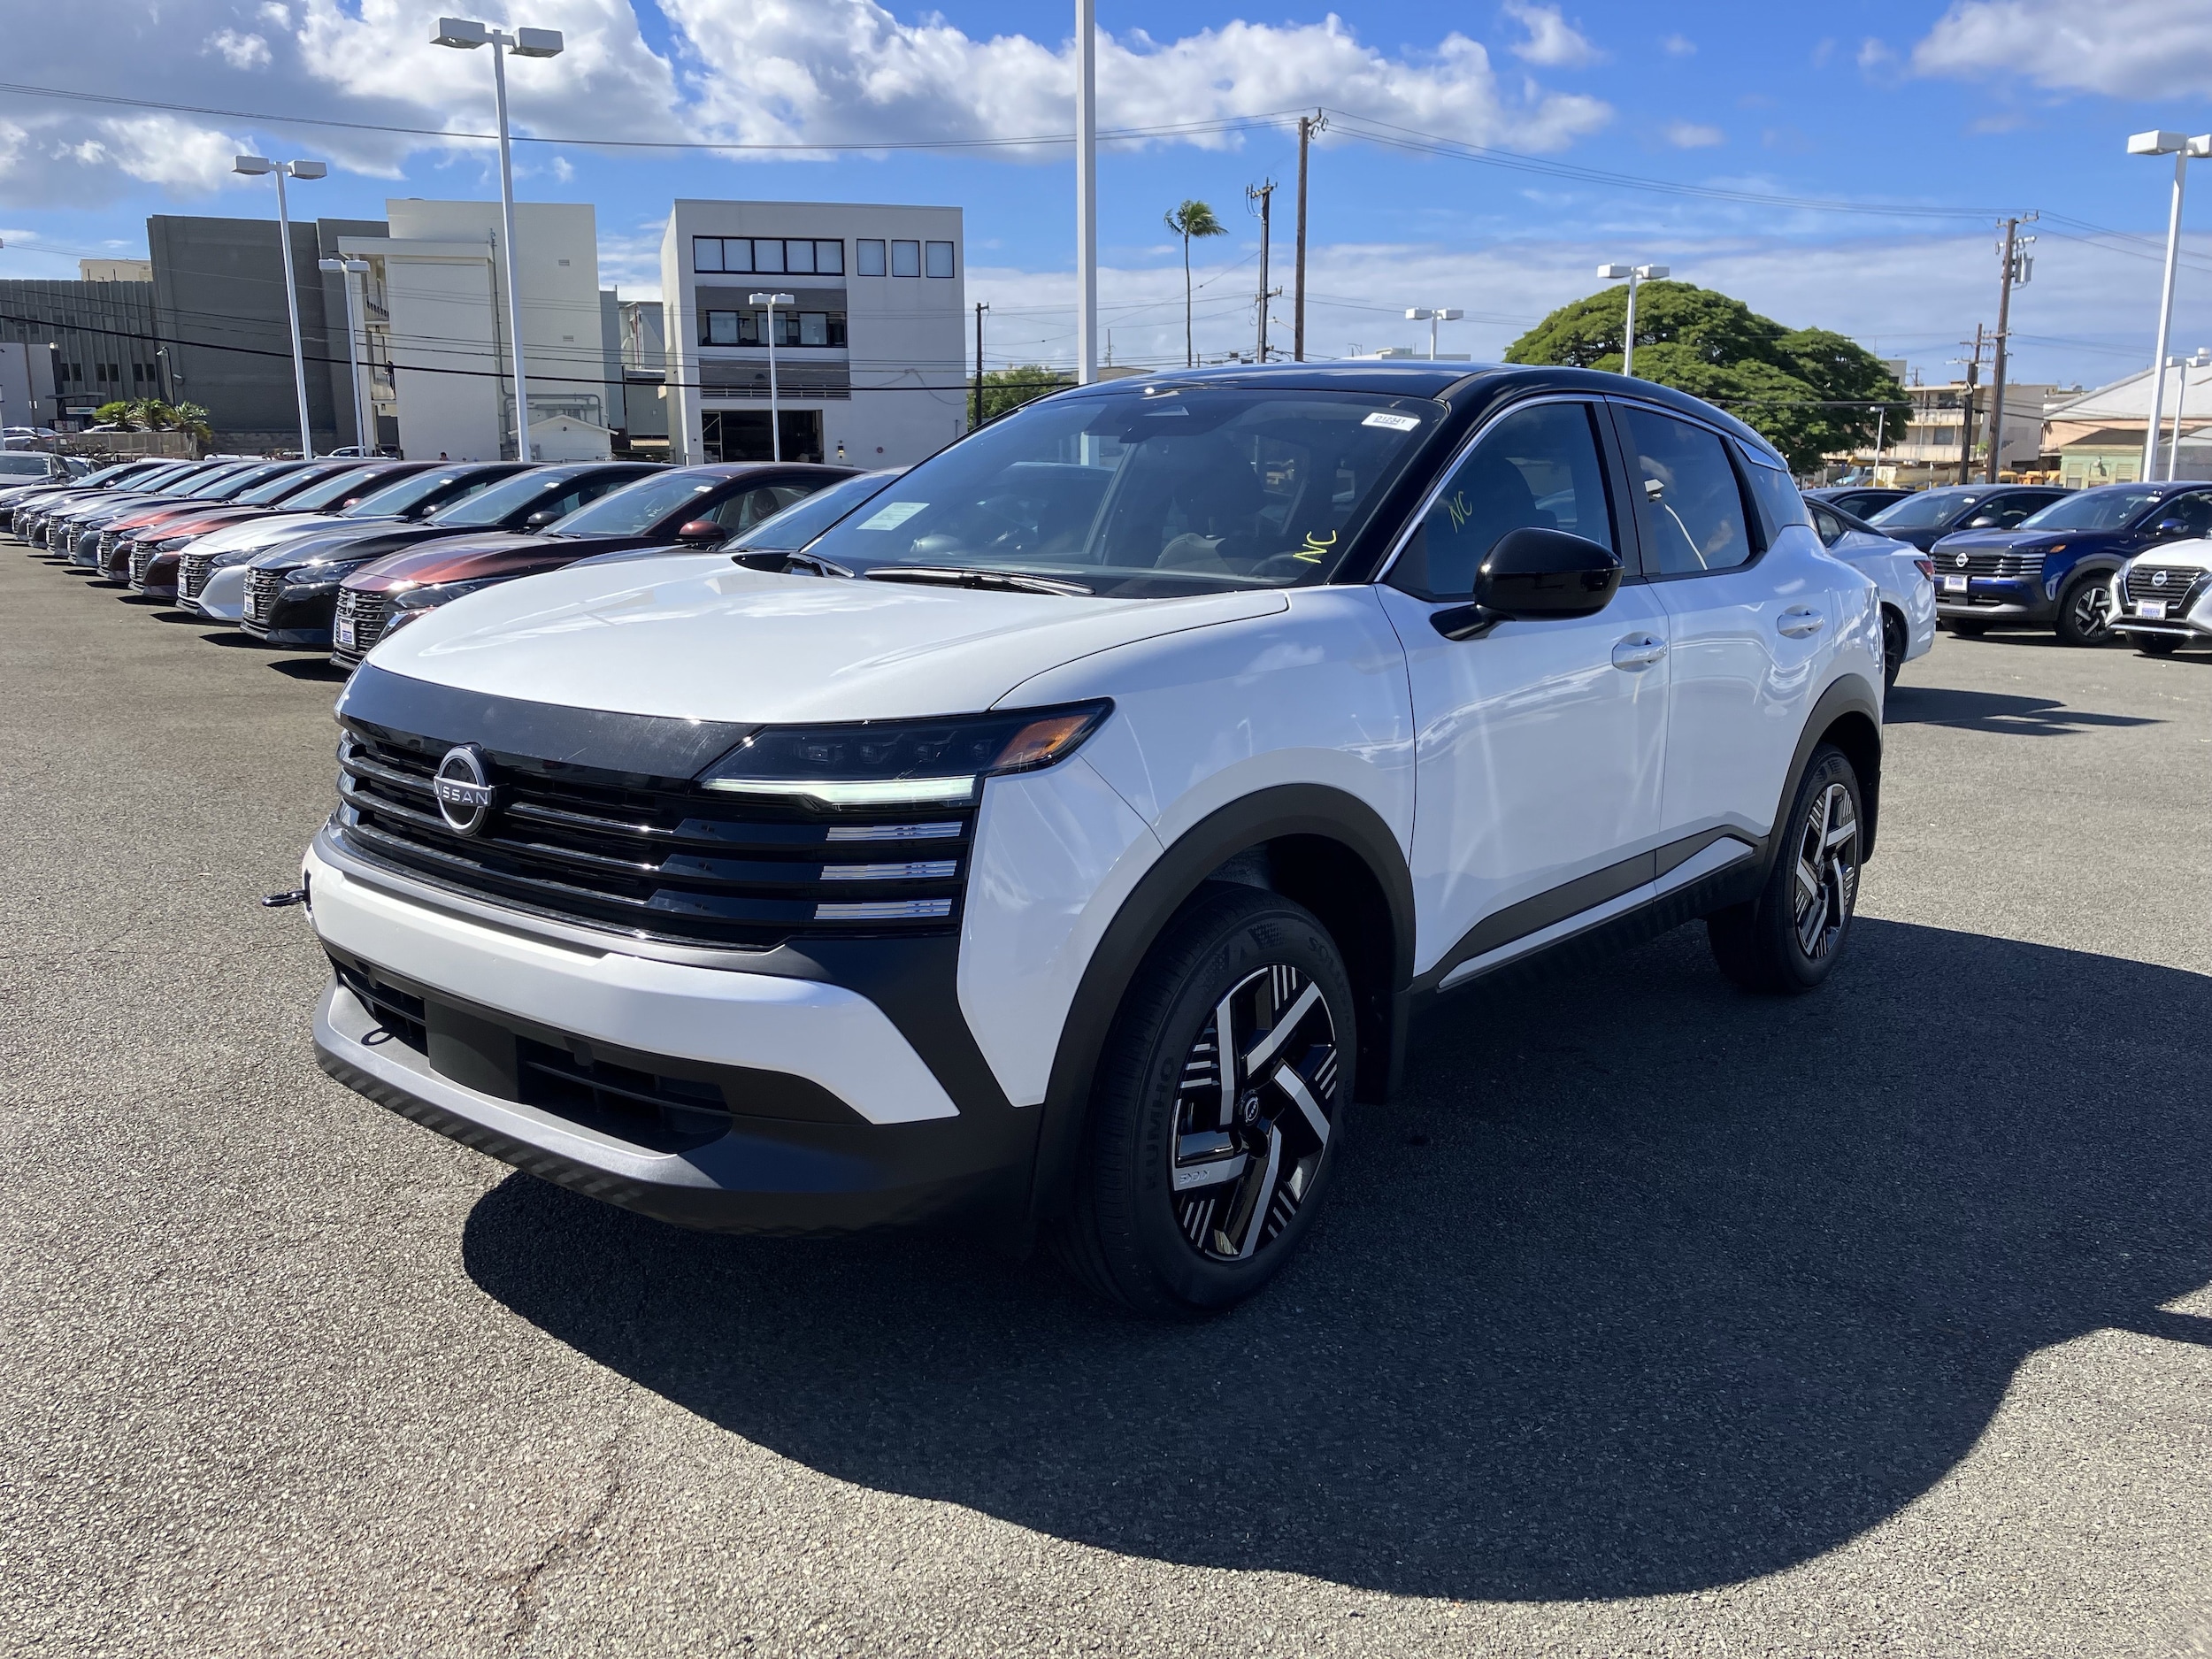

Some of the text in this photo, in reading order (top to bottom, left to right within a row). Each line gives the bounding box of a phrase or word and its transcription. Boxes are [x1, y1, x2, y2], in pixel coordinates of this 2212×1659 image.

[1448, 490, 1473, 534] NC
[1292, 529, 1337, 564] NC
[434, 780, 488, 804] NISSAN
